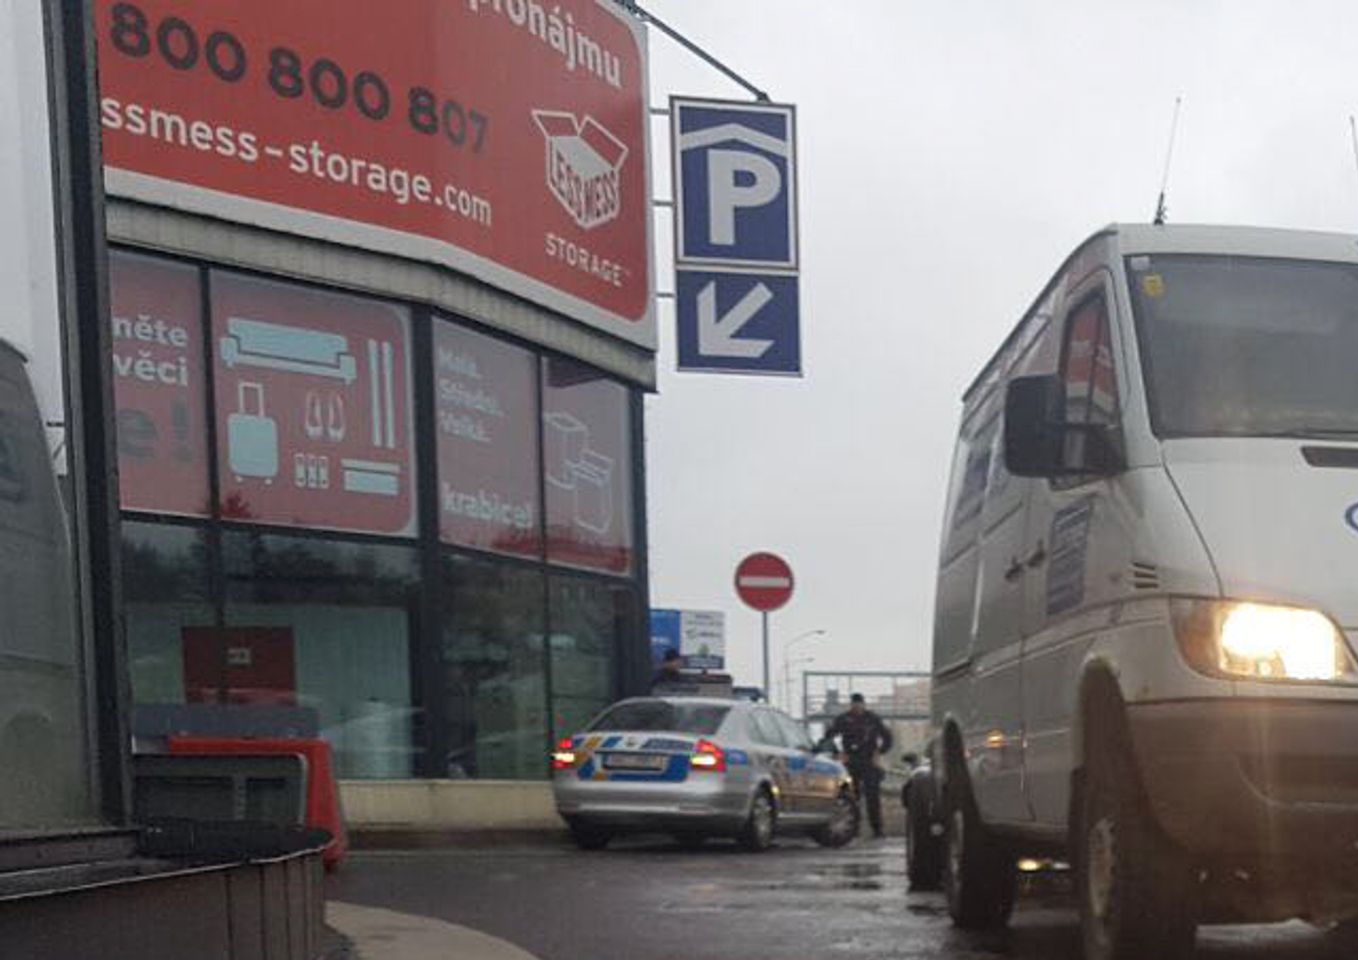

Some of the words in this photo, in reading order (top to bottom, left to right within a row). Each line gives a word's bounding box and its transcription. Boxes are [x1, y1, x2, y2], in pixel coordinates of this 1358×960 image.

[110, 2, 247, 83] 800
[266, 46, 390, 121] 800
[408, 86, 488, 153] 807
[707, 149, 781, 245] P
[545, 232, 622, 288] STORAGE
[112, 314, 188, 347] něte
[112, 350, 188, 386] věci
